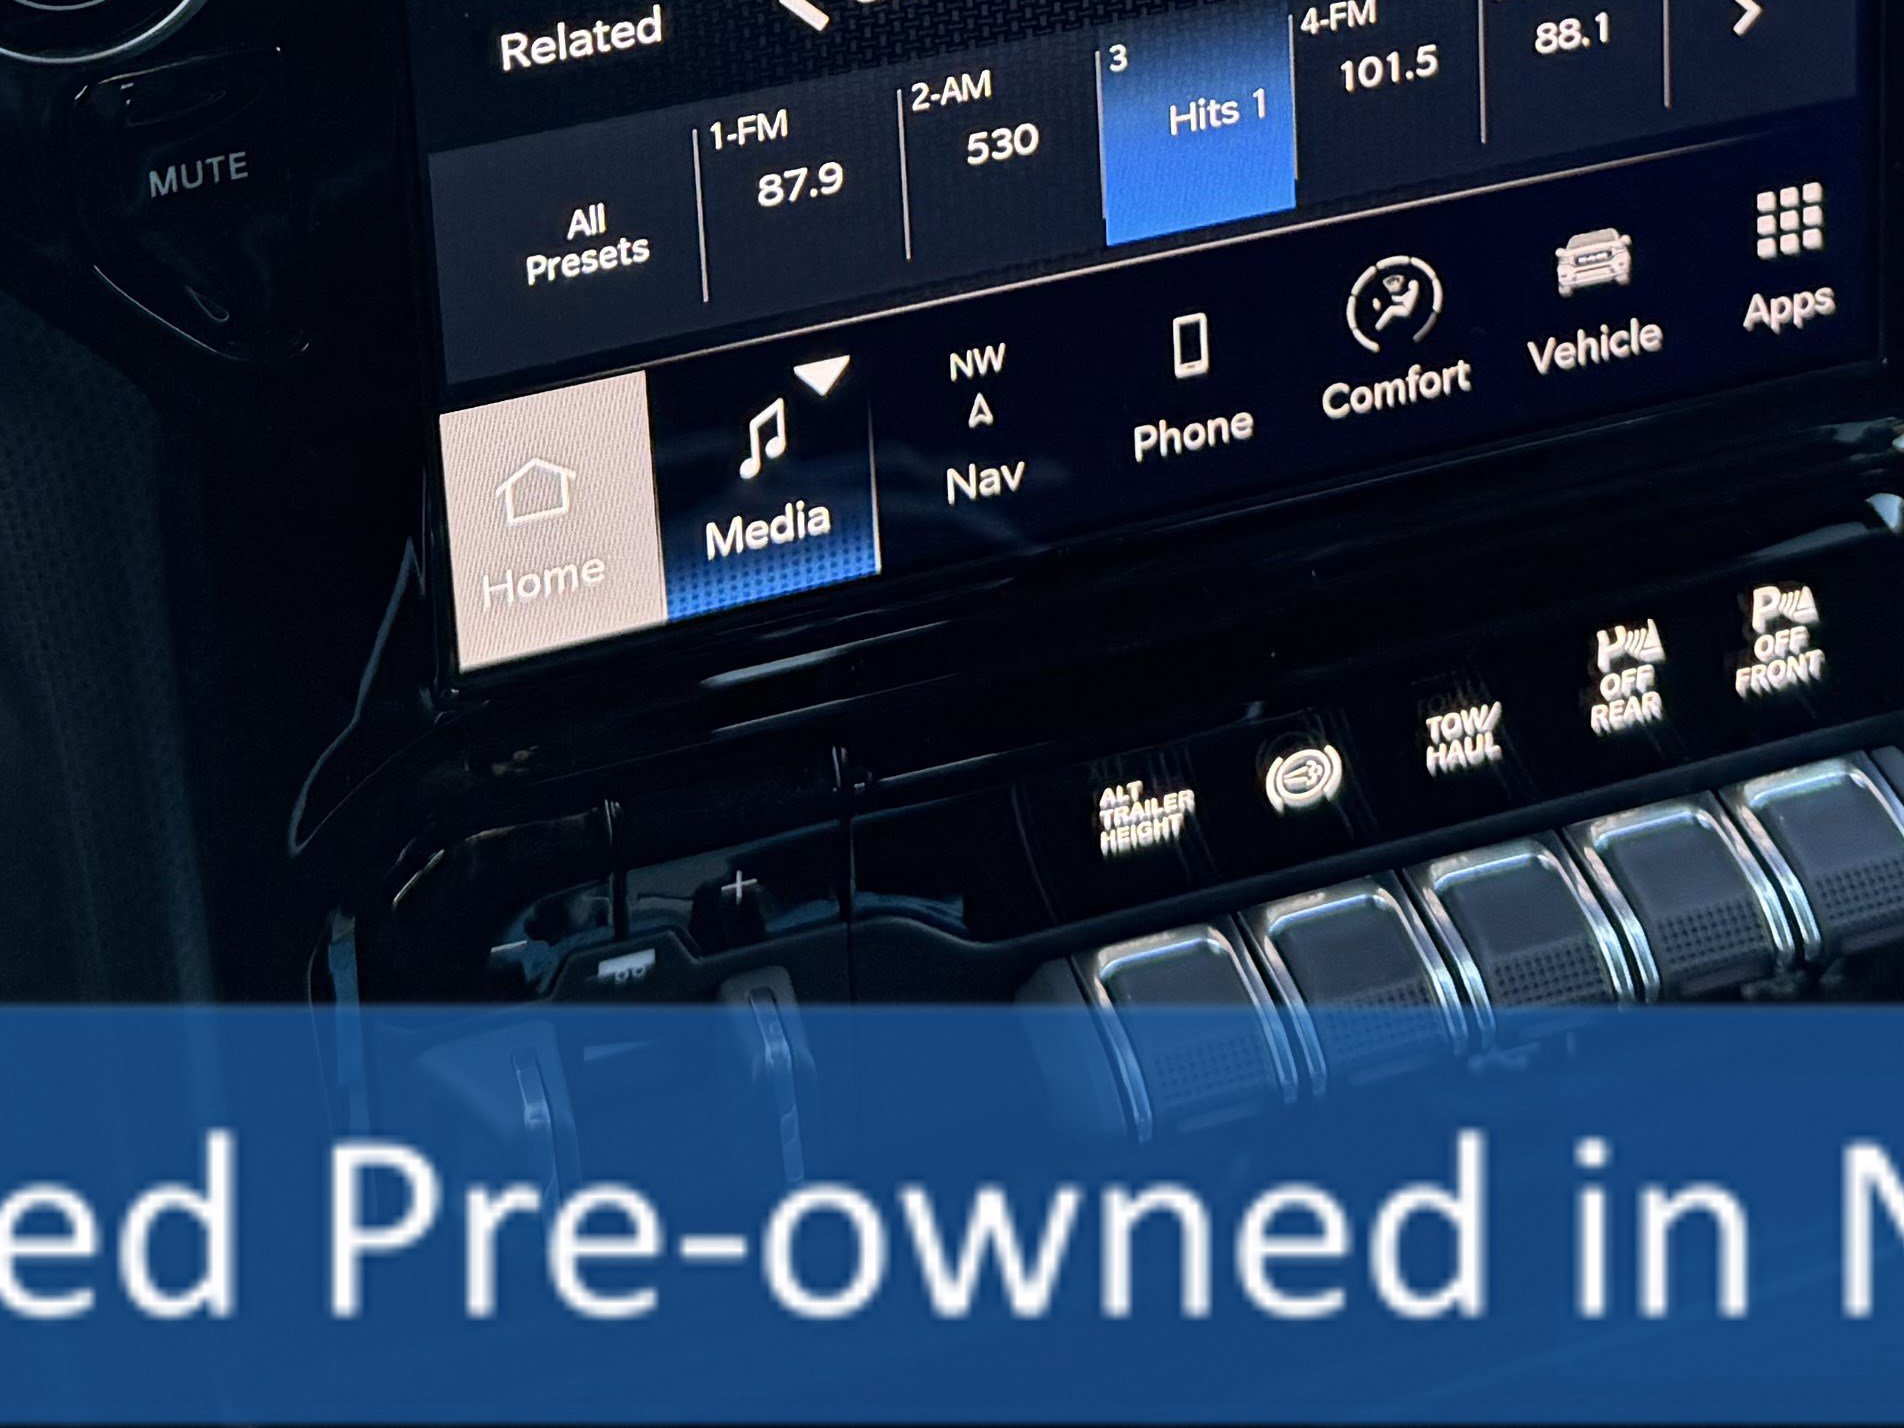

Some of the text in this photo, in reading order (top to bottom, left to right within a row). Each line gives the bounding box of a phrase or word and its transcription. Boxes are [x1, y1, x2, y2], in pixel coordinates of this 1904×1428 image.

[499, 4, 664, 72] Related
[1533, 12, 1612, 56] 88.1
[1108, 44, 1129, 74] 3
[1338, 44, 1440, 94] 101.5
[910, 69, 992, 113] 2-AM
[1168, 88, 1268, 137] Hits 1
[709, 109, 789, 151] 1-FM
[966, 123, 1040, 167] 530
[148, 150, 250, 198] MUTE
[756, 161, 845, 209] 87.9
[566, 202, 606, 241] All
[525, 236, 651, 287] Presets
[1741, 283, 1837, 336] Apps
[948, 342, 1007, 383] NW
[1526, 317, 1665, 375] Vehicle
[1321, 358, 1473, 421] Comfort
[1132, 407, 1256, 464] Phone
[945, 460, 1026, 506] Nav
[705, 500, 832, 562] Media
[480, 552, 607, 613] Home
[1753, 625, 1811, 664] OFF
[1599, 664, 1656, 702] OFF
[1734, 649, 1826, 701] FRONT
[1590, 691, 1664, 737] REAR
[1425, 732, 1503, 778] HAUL
[1099, 780, 1144, 809] ALT
[1099, 789, 1195, 832] TRAILER
[1100, 813, 1184, 856] HEIGHT
